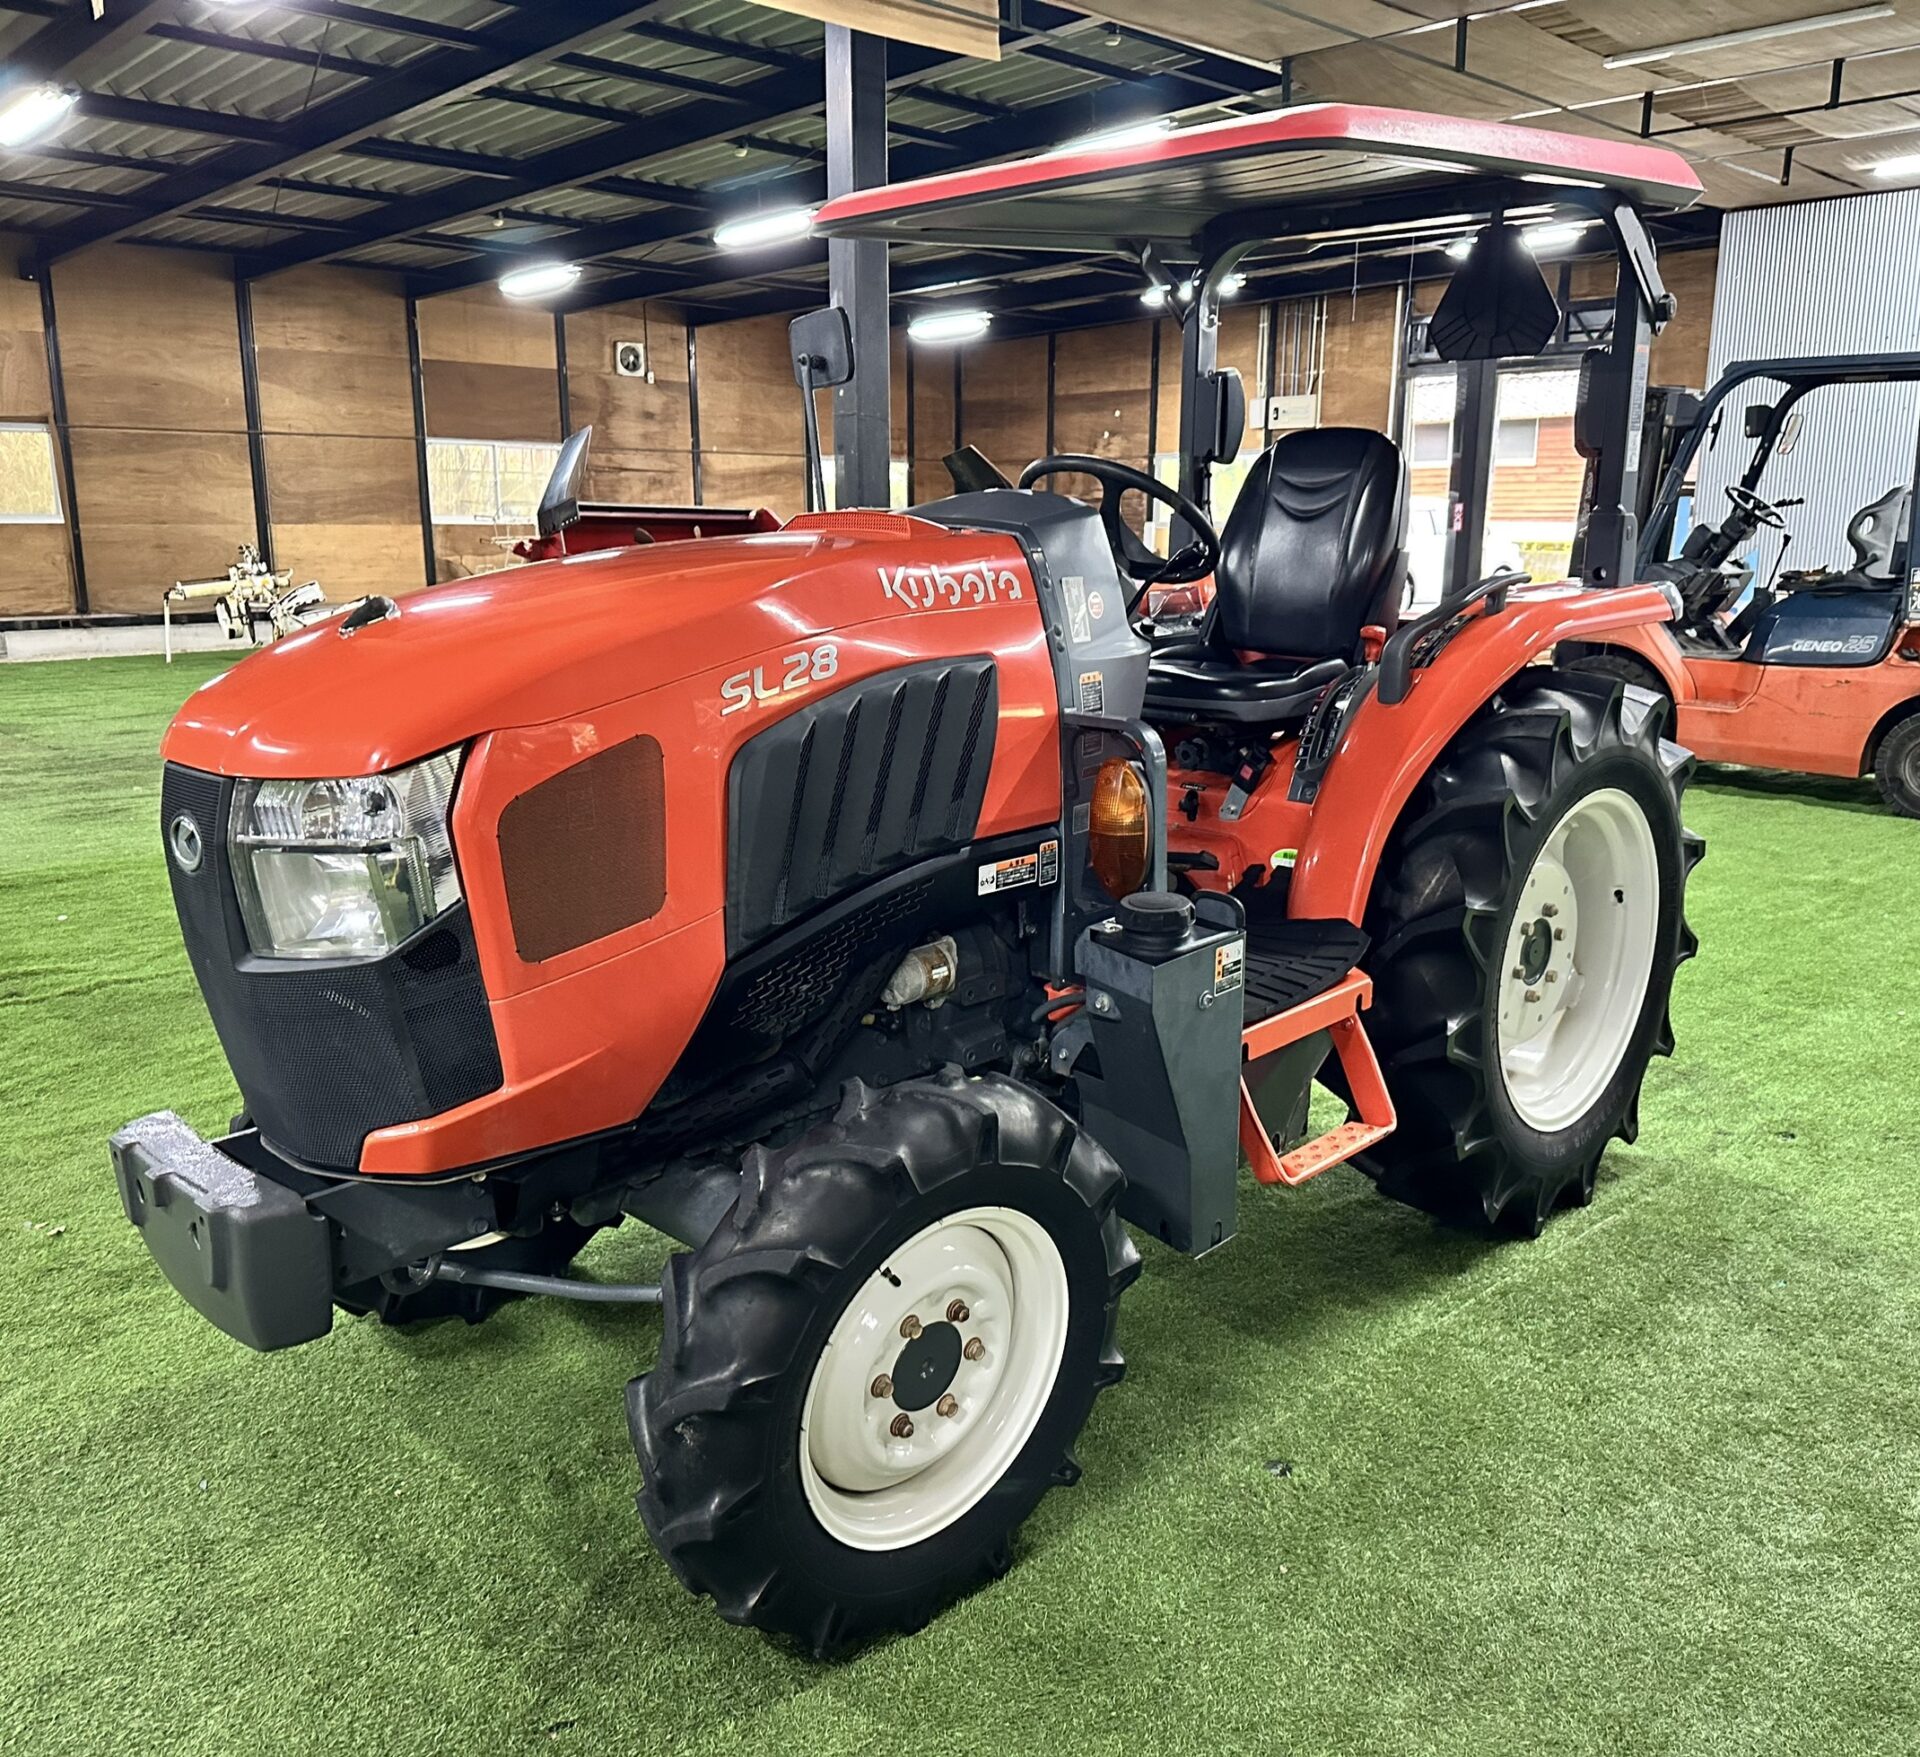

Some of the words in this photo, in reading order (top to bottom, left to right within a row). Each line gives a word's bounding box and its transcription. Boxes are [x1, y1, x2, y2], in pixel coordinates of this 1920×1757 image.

[876, 561, 1023, 609] Kubota
[1792, 639, 1843, 653] GENEO
[720, 643, 839, 717] SL28
